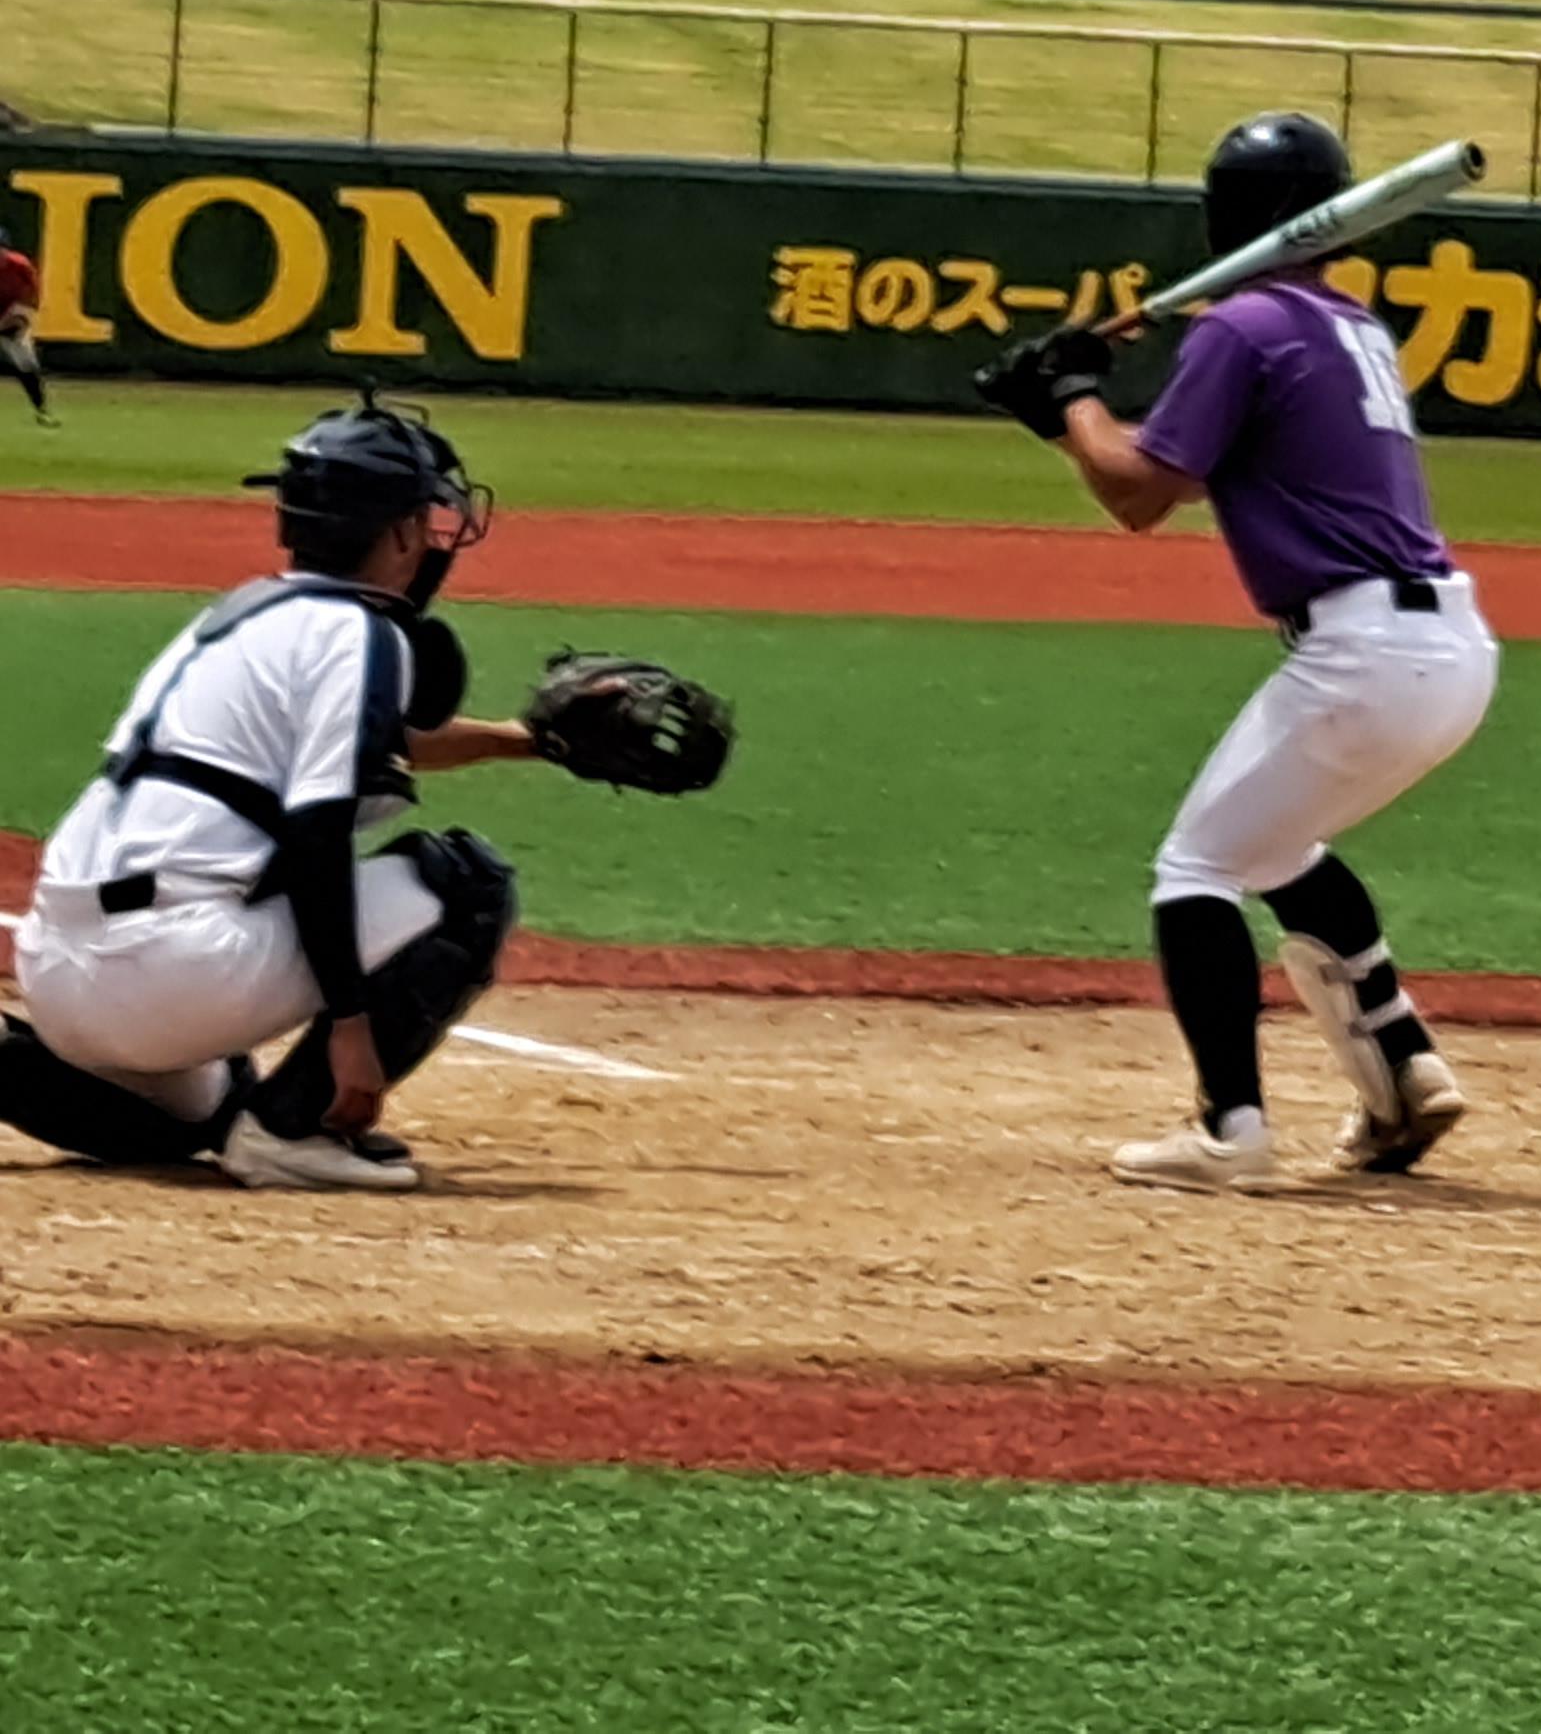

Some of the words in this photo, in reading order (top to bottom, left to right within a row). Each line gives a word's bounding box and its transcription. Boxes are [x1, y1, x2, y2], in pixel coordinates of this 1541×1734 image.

[10, 169, 565, 361] ION
[768, 244, 1212, 342] 酒のスーパ
